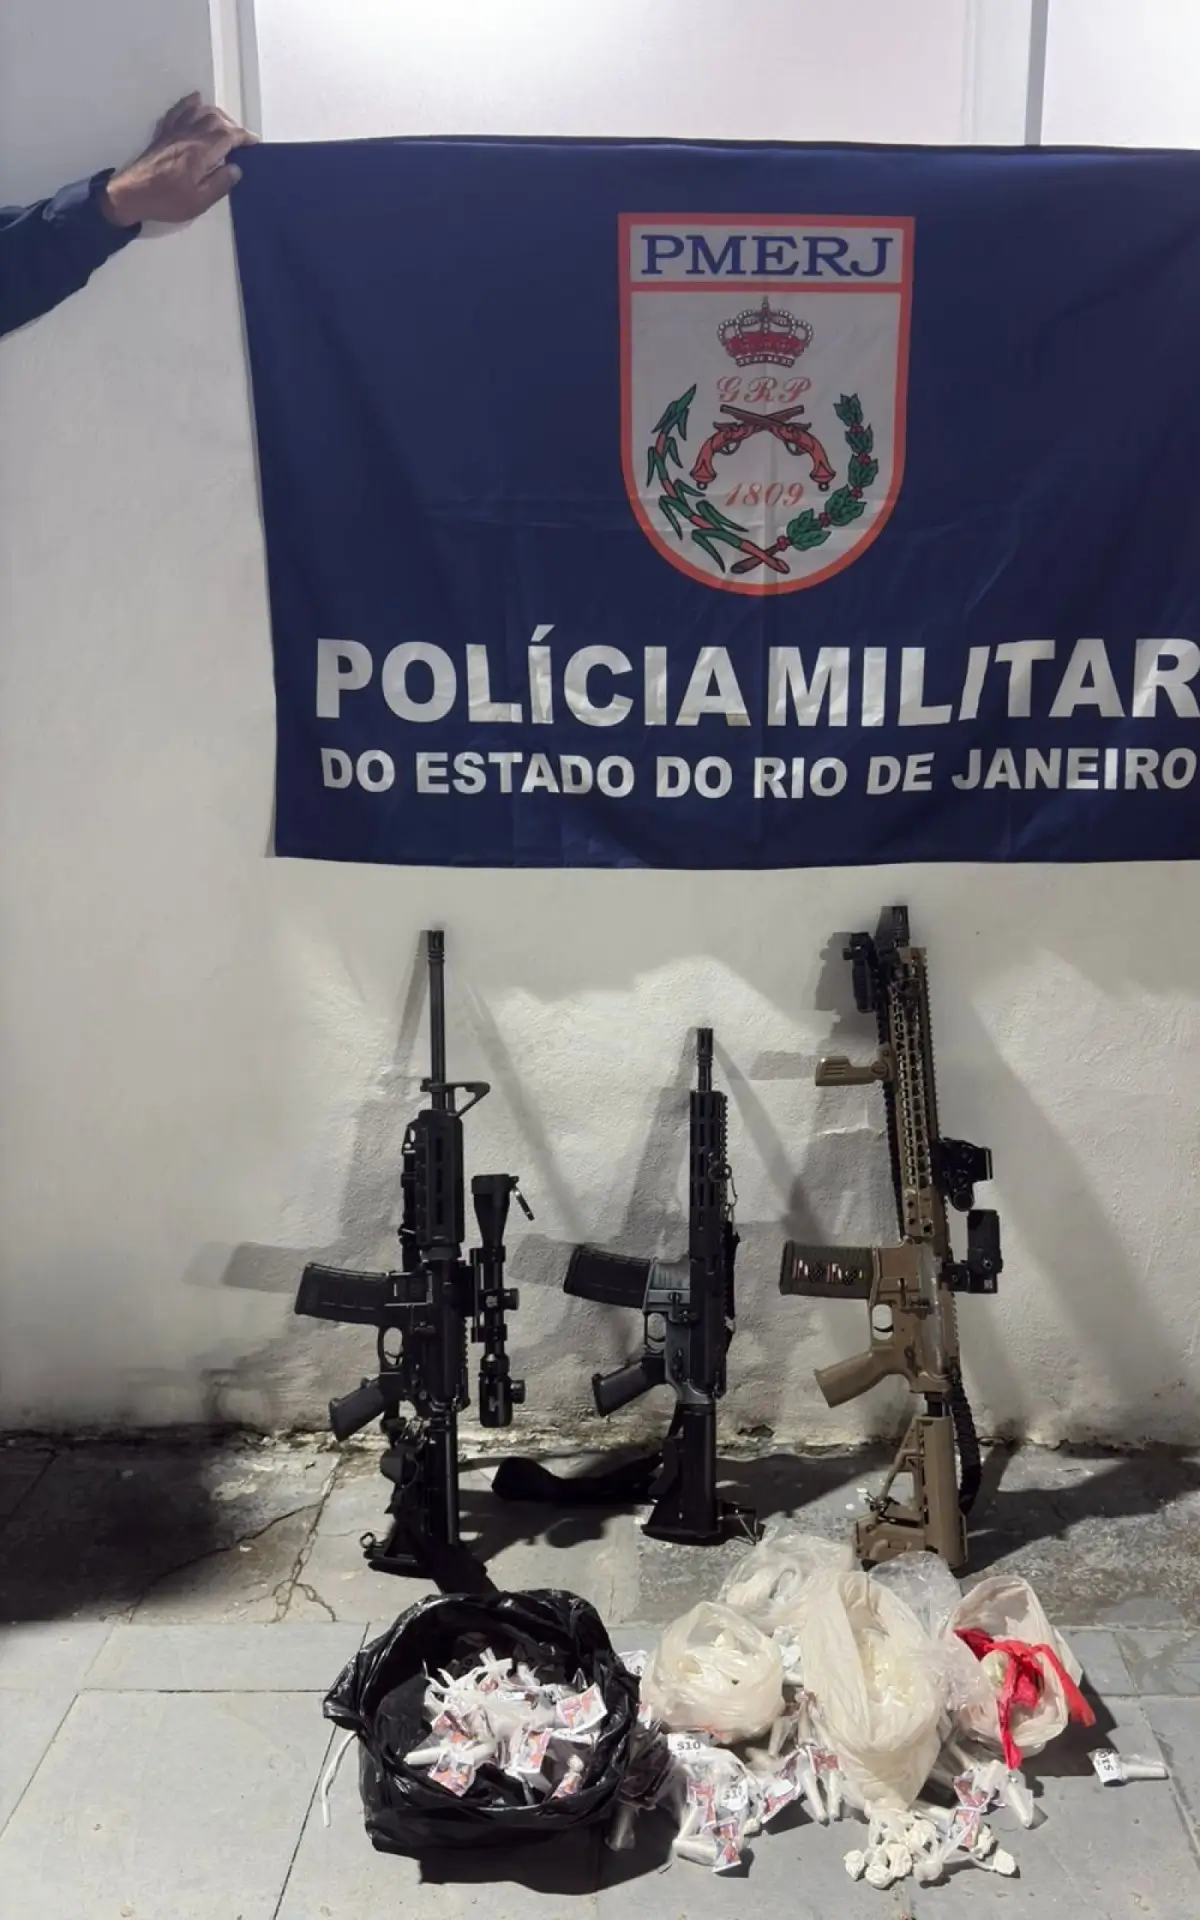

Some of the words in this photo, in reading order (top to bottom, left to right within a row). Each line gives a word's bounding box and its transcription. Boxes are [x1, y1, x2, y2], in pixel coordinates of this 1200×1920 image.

[640, 234, 894, 277] PMERJ
[723, 481, 805, 508] 1809
[316, 624, 751, 727] POLÍCIA
[767, 638, 1200, 727] MILITAR
[321, 747, 396, 793] DO
[416, 751, 635, 798] ESTADO
[656, 755, 733, 799] DO
[753, 757, 848, 799] RIO
[866, 752, 934, 795] DE
[951, 747, 1197, 790] JANEIRO
